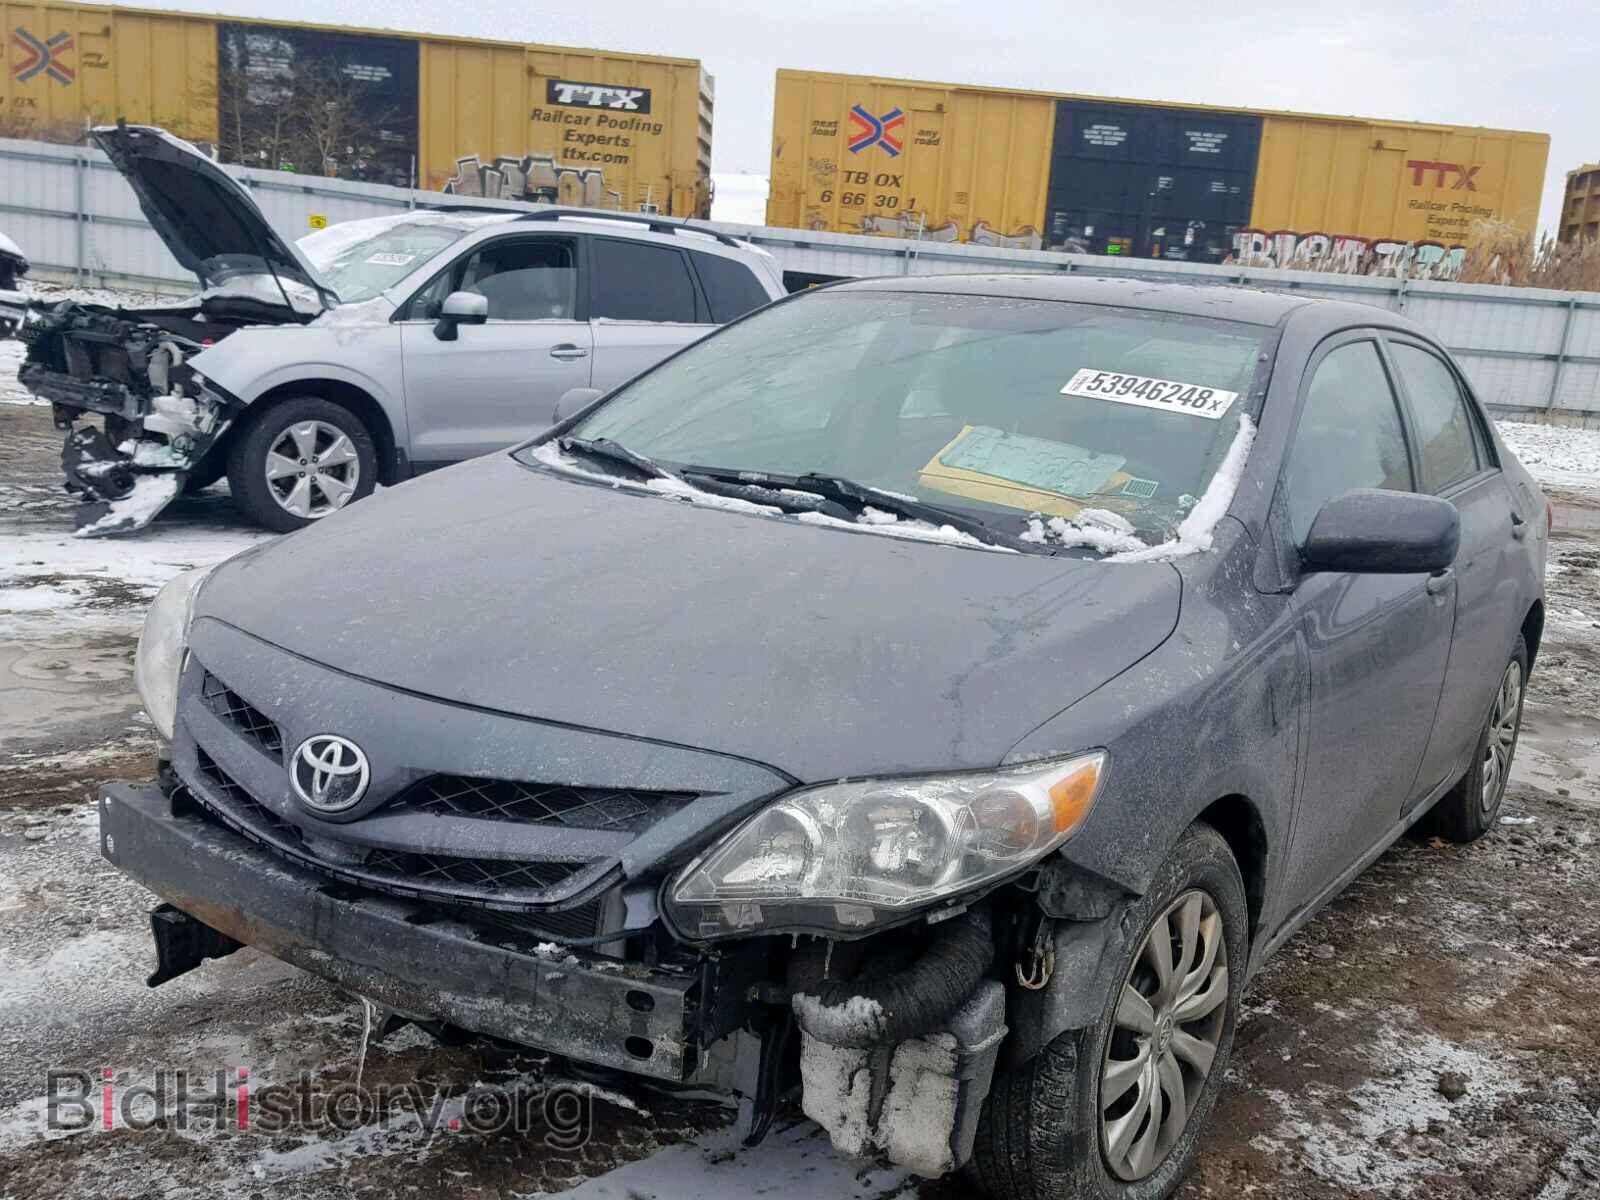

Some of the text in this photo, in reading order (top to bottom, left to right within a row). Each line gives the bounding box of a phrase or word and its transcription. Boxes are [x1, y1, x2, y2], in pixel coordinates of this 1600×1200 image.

[554, 83, 644, 111] TTX
[530, 108, 663, 135] Railcar Pooling
[563, 129, 631, 148] Experts
[811, 127, 838, 137] load
[562, 147, 630, 165] ttx.com
[1407, 159, 1483, 193] TTX
[1408, 199, 1494, 219] Railcar Pooling
[1425, 213, 1471, 229] Experts
